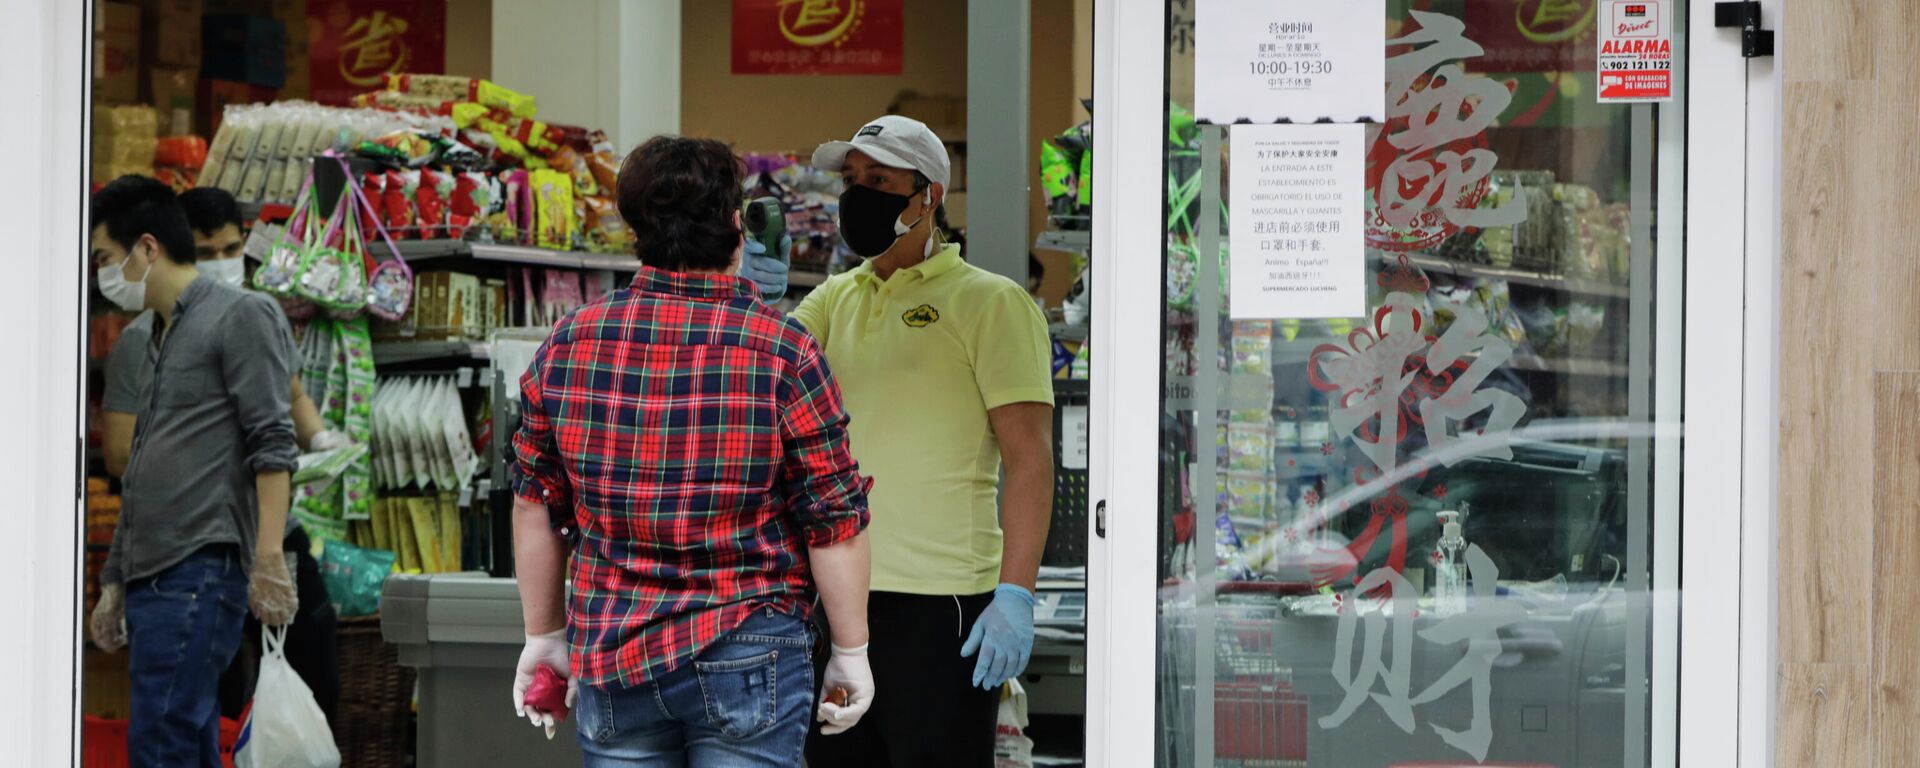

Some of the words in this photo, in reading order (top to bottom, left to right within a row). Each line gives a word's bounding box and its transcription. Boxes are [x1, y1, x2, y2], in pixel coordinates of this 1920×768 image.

[1268, 22, 1313, 34] 营业时间
[1618, 20, 1654, 35] Direct
[1258, 43, 1321, 52] 星期一至星期天
[1601, 39, 1670, 53] ALARMA
[1249, 60, 1332, 75] 10:00-19:30
[1610, 61, 1628, 69] 902
[1632, 61, 1648, 69] 121
[1653, 61, 1670, 69] 122
[1268, 77, 1311, 87] 中午不休息
[1261, 164, 1270, 172] LA
[1272, 164, 1307, 172] ENTRADA
[1309, 164, 1315, 172] A
[1317, 164, 1333, 172] ESTE
[1258, 178, 1325, 186] ESTABLECIMIENTO
[1327, 178, 1336, 186] ES
[1305, 193, 1312, 201] EL
[1314, 193, 1331, 201] USO
[1333, 193, 1342, 201] DE
[1251, 207, 1298, 215] MASCARILLA
[1307, 207, 1342, 215] GUANTES
[1254, 221, 1340, 234] 进店前必须使用
